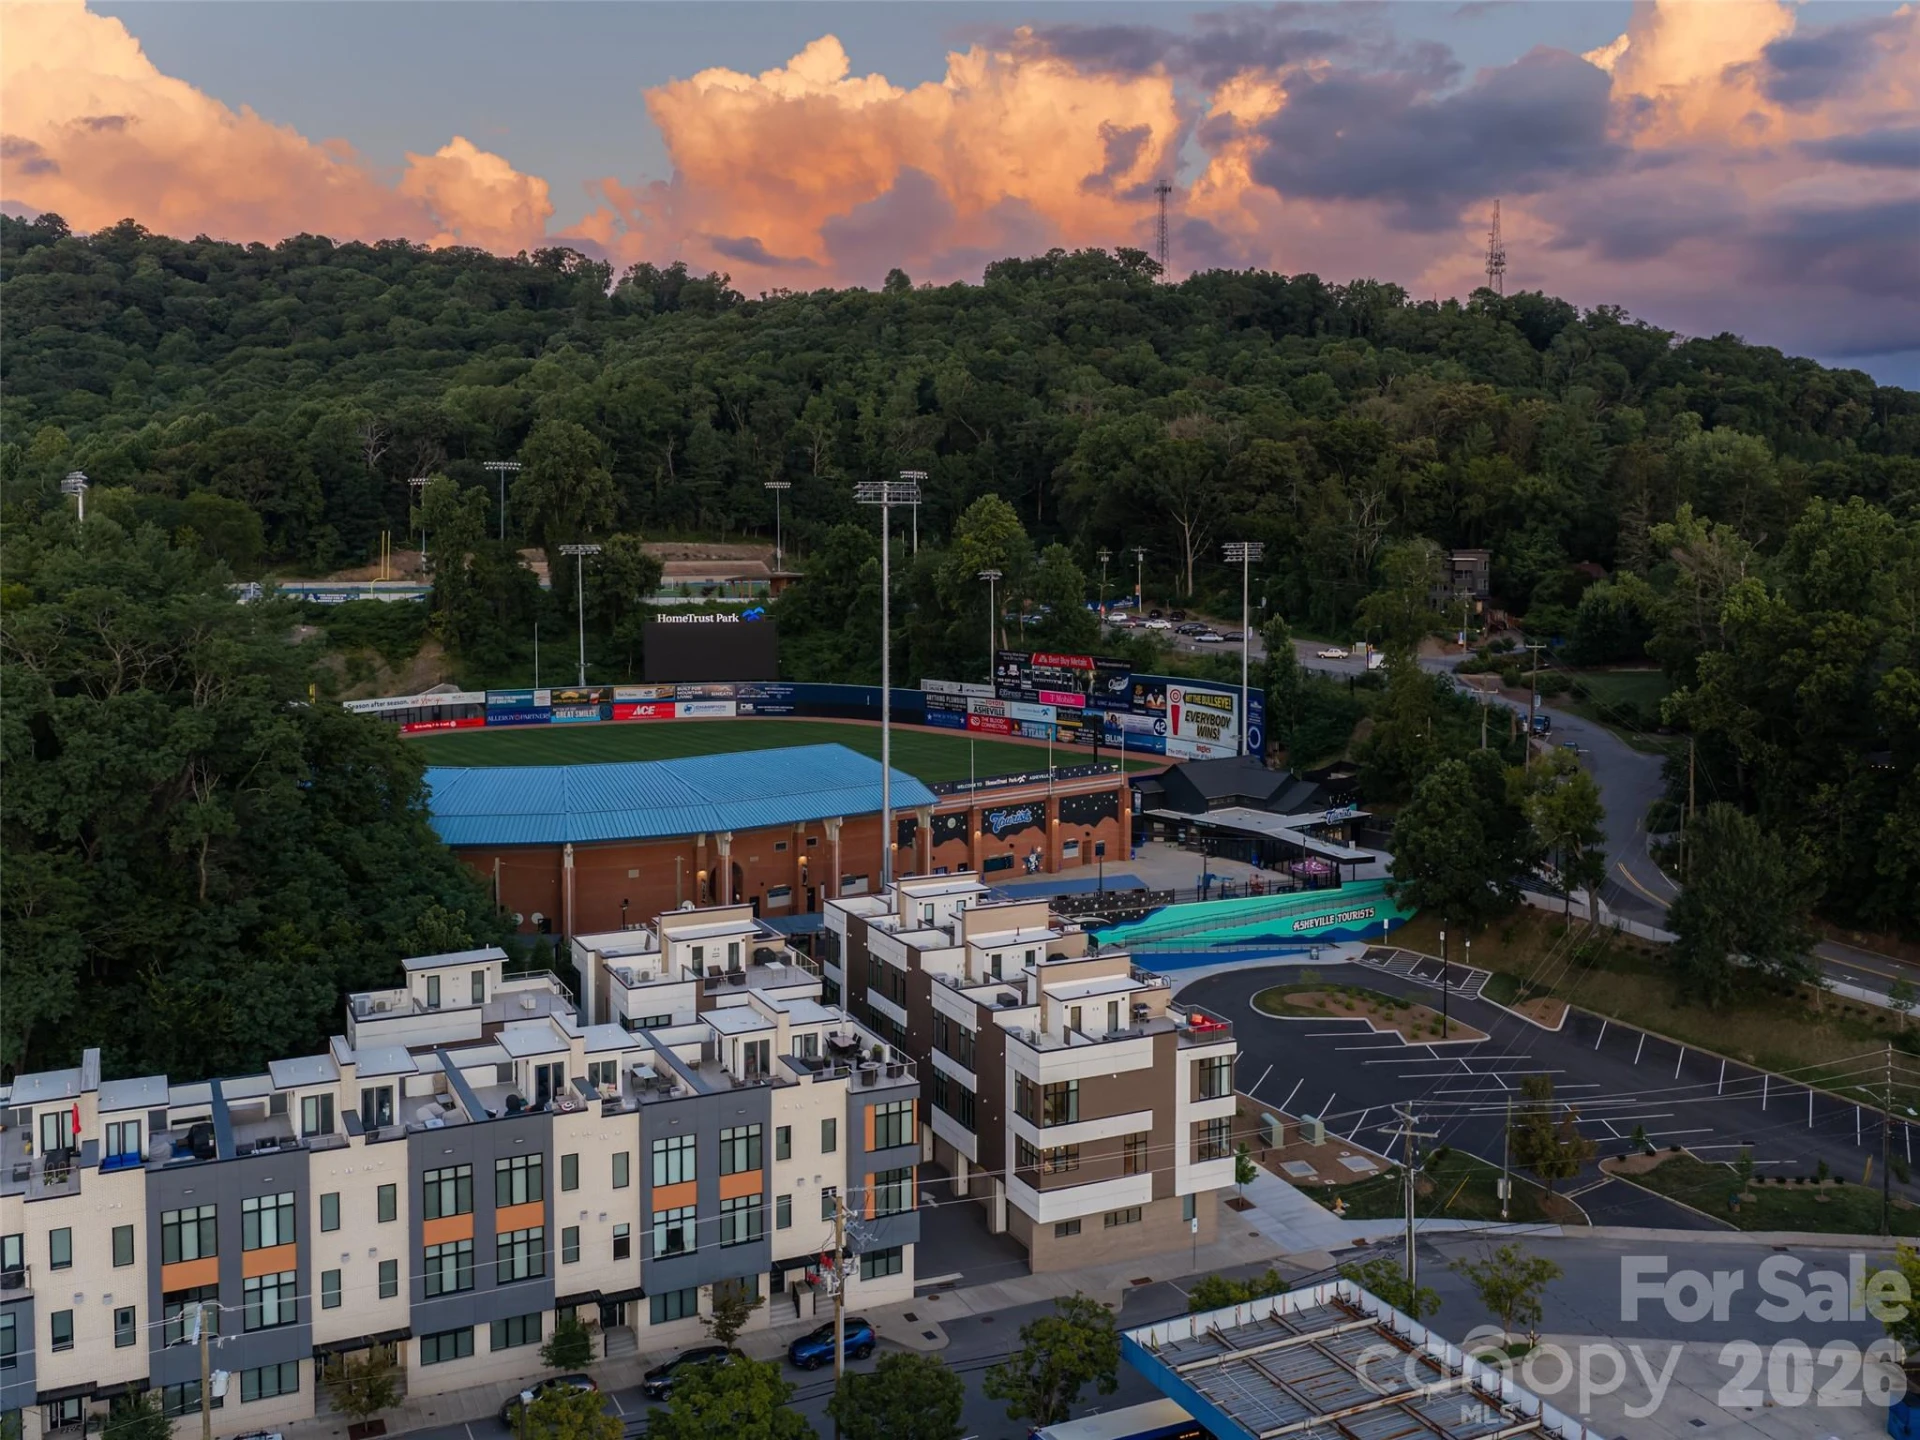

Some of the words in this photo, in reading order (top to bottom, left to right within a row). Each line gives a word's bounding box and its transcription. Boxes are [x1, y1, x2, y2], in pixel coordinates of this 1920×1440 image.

[657, 613, 714, 624] HomeTrust
[716, 613, 739, 623] Park
[348, 702, 366, 710] Season
[387, 699, 408, 707] season.
[1185, 694, 1194, 703] HIT
[1194, 695, 1202, 704] THE
[1202, 695, 1232, 710] BULLSEYE!
[555, 710, 575, 719] GREAT
[575, 709, 597, 718] SMILES
[633, 705, 655, 715] ACE
[974, 707, 1005, 716] ASHEVILLE
[1185, 711, 1231, 728] EVERYBODY
[981, 722, 1007, 730] CONNECTION
[1155, 722, 1166, 733] 42
[1197, 726, 1220, 740] WINS!
[990, 809, 1032, 833] Tourists
[1293, 915, 1335, 932] ASHEVILLE
[1337, 907, 1375, 924] TOURISTS
